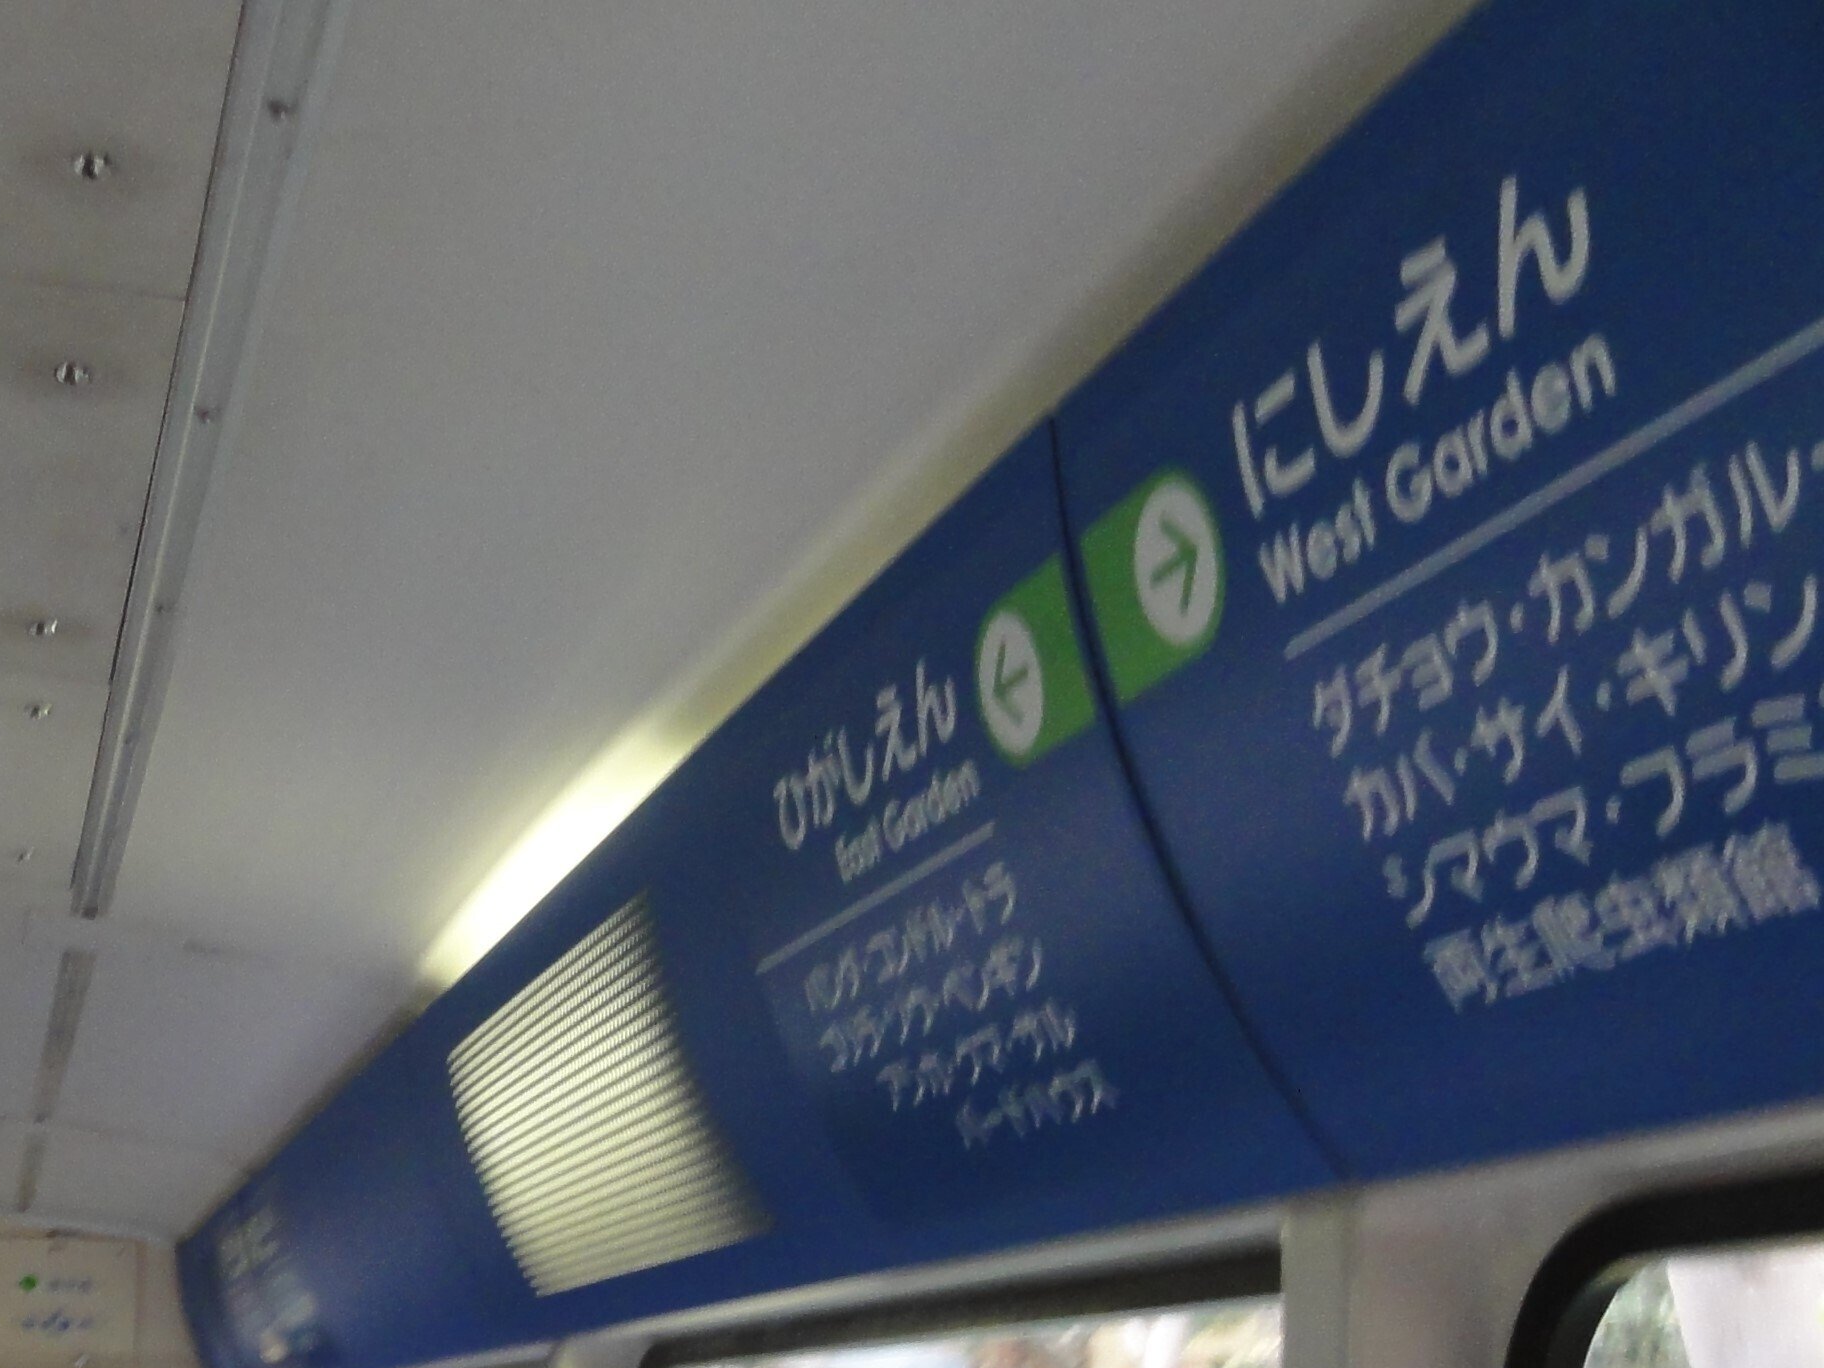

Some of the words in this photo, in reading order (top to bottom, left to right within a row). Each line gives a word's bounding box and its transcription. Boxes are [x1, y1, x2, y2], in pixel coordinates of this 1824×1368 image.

[1231, 174, 1591, 520] にしえん
[1258, 477, 1376, 603] West
[1385, 333, 1617, 523] Garden
[773, 656, 958, 851] ひがしえん
[1380, 684, 1824, 930] シマウマ・フラミ
